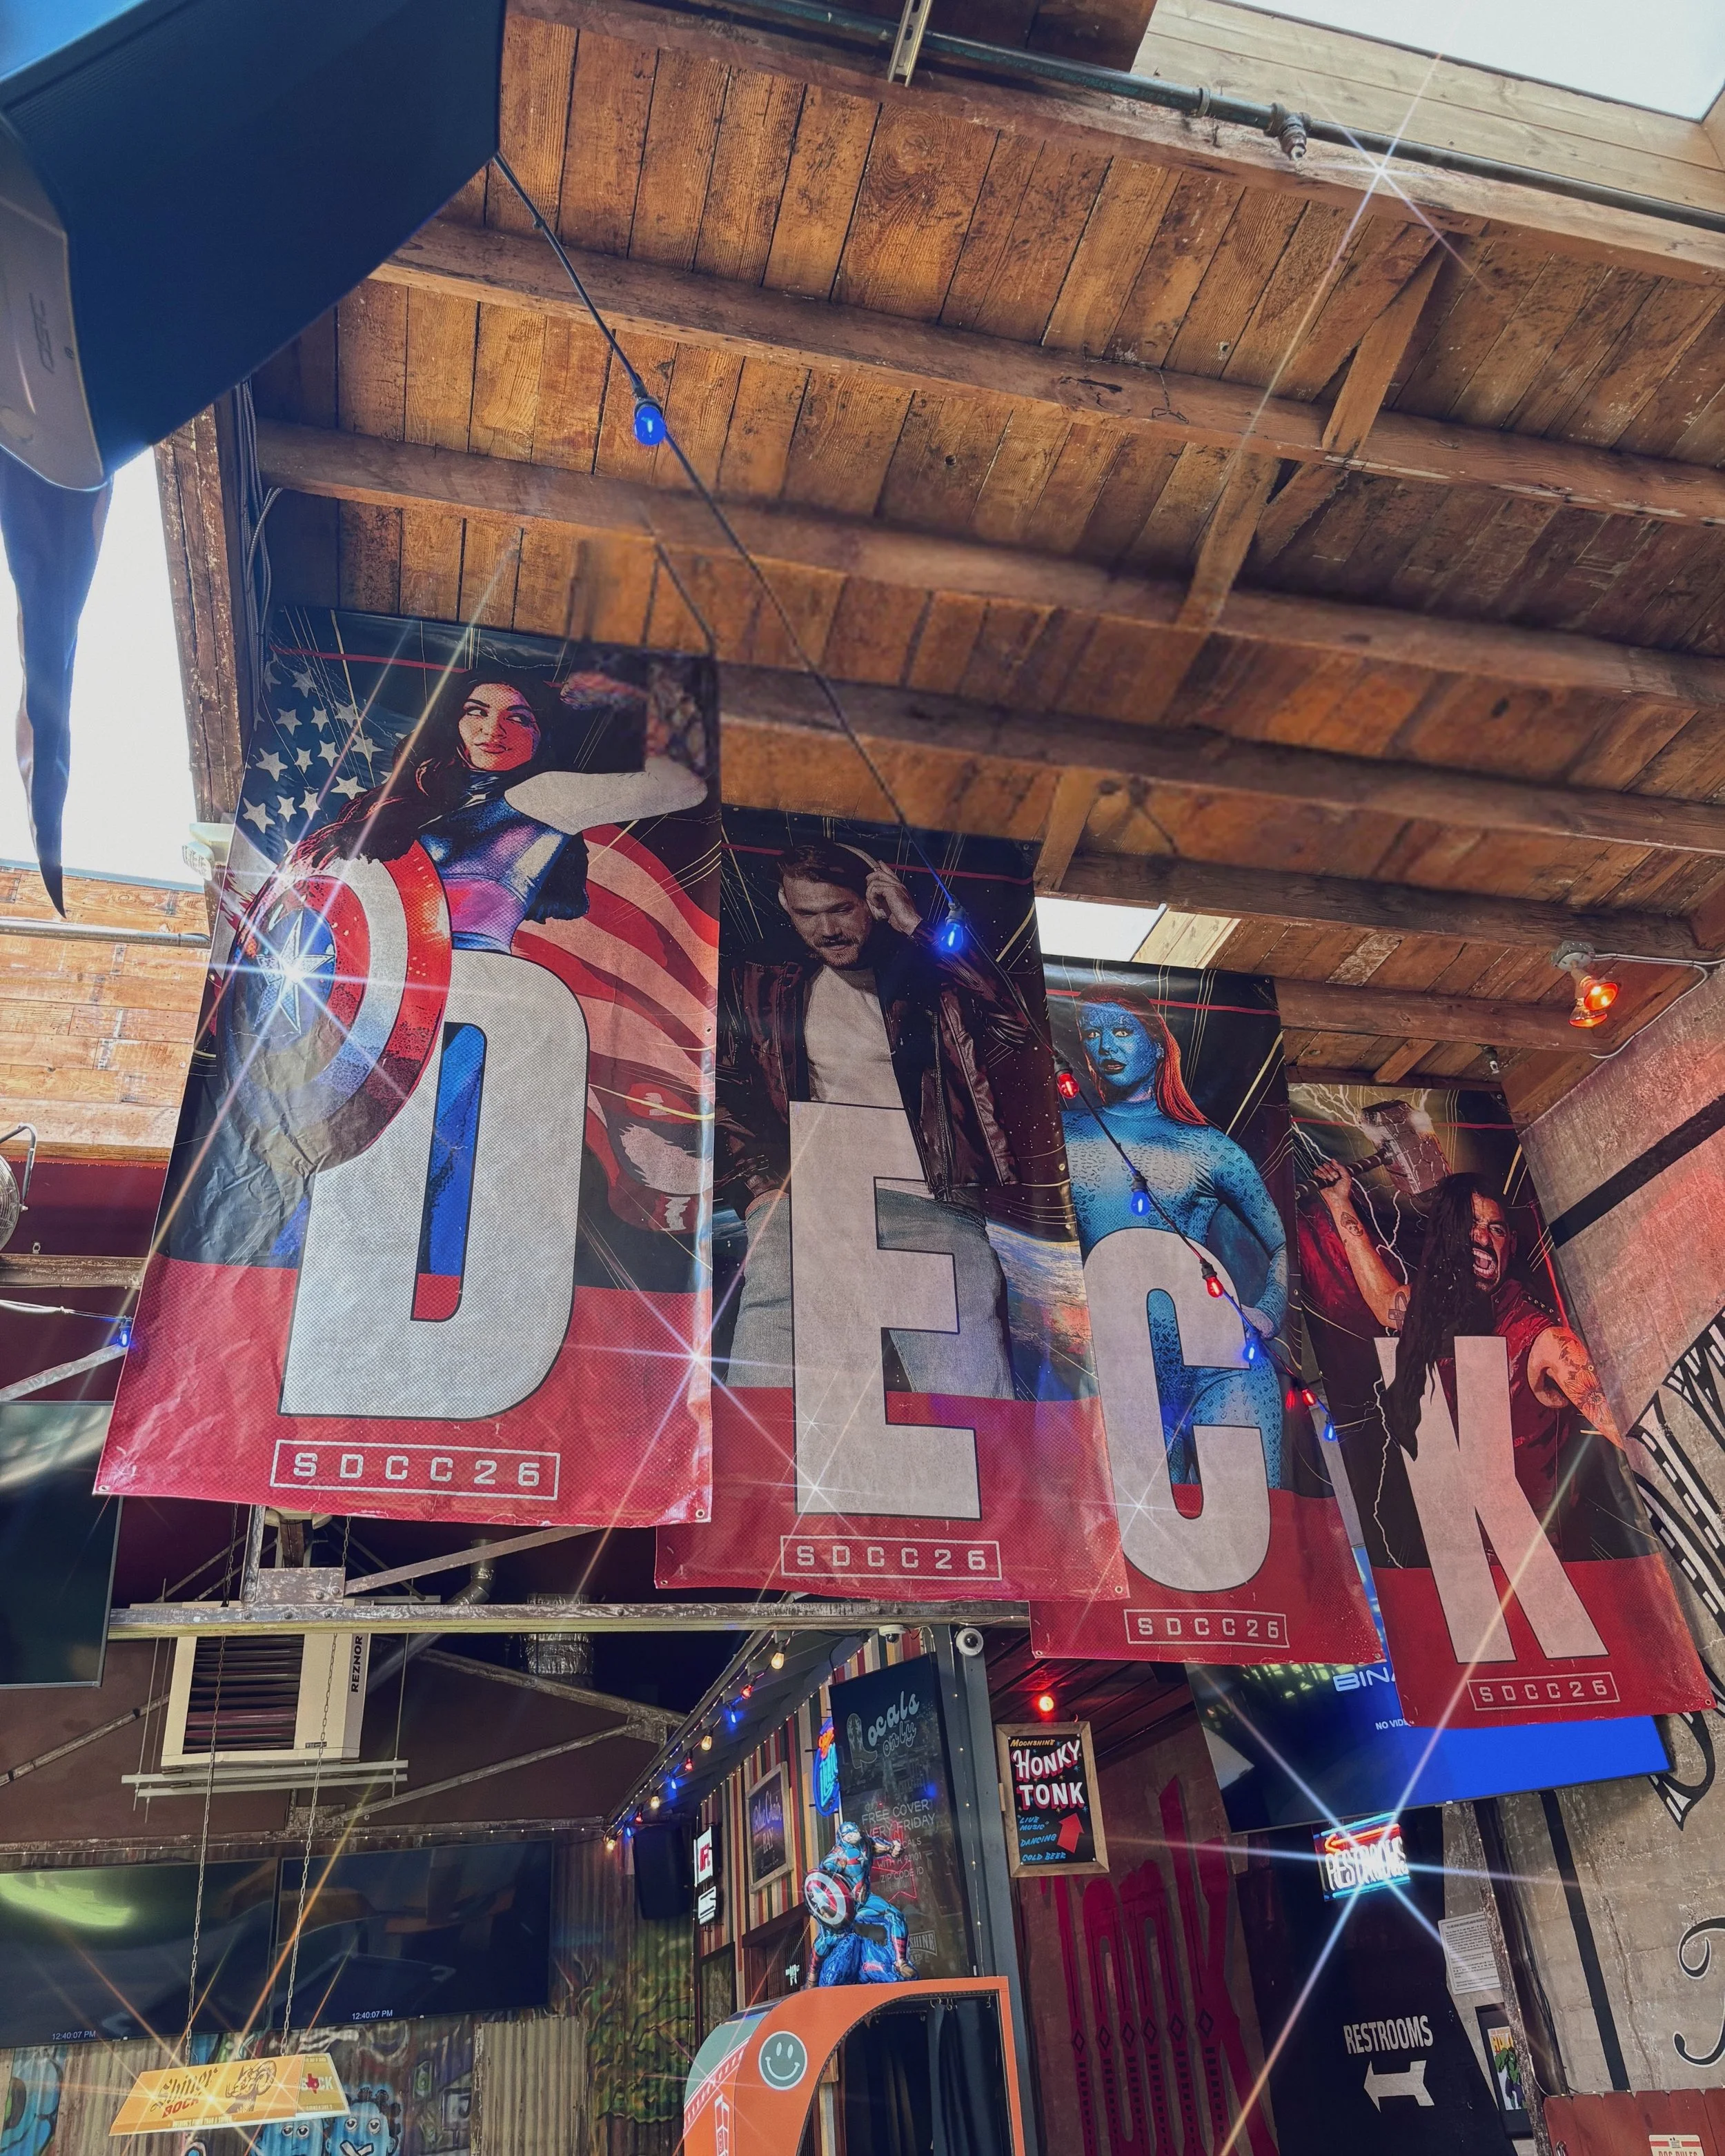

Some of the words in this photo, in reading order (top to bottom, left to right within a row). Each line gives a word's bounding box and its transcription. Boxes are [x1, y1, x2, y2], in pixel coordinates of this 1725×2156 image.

[278, 949, 589, 1421] D
[789, 1101, 981, 1522] E
[1083, 1227, 1270, 1592] C
[1374, 1336, 1609, 1664] K
[351, 1635, 364, 1693] REZNOR
[883, 1720, 917, 1757] only
[1375, 1721, 1389, 1730] NO
[1012, 1740, 1080, 1781] HONKY
[1017, 1782, 1085, 1808] TONK
[862, 1810, 890, 1825] FREE
[892, 1799, 930, 1818] COVER
[864, 1823, 893, 1838] VERY
[896, 1813, 936, 1831] FRIDAY
[902, 1837, 922, 1849] CALS
[1021, 1833, 1057, 1847] DANCING
[877, 1858, 896, 1868] WITH
[1045, 1852, 1066, 1860] BEER
[880, 1875, 892, 1883] ZIP
[894, 1868, 914, 1880] CODE
[916, 1866, 924, 1875] ID
[352, 2011, 379, 2021] 12:40:07
[382, 2010, 393, 2018] PM
[52, 2031, 83, 2041] 12:40:07
[1343, 2015, 1434, 2055] RESTROOMS
[150, 2068, 213, 2112] Shiner
[301, 2075, 334, 2092] BCK
